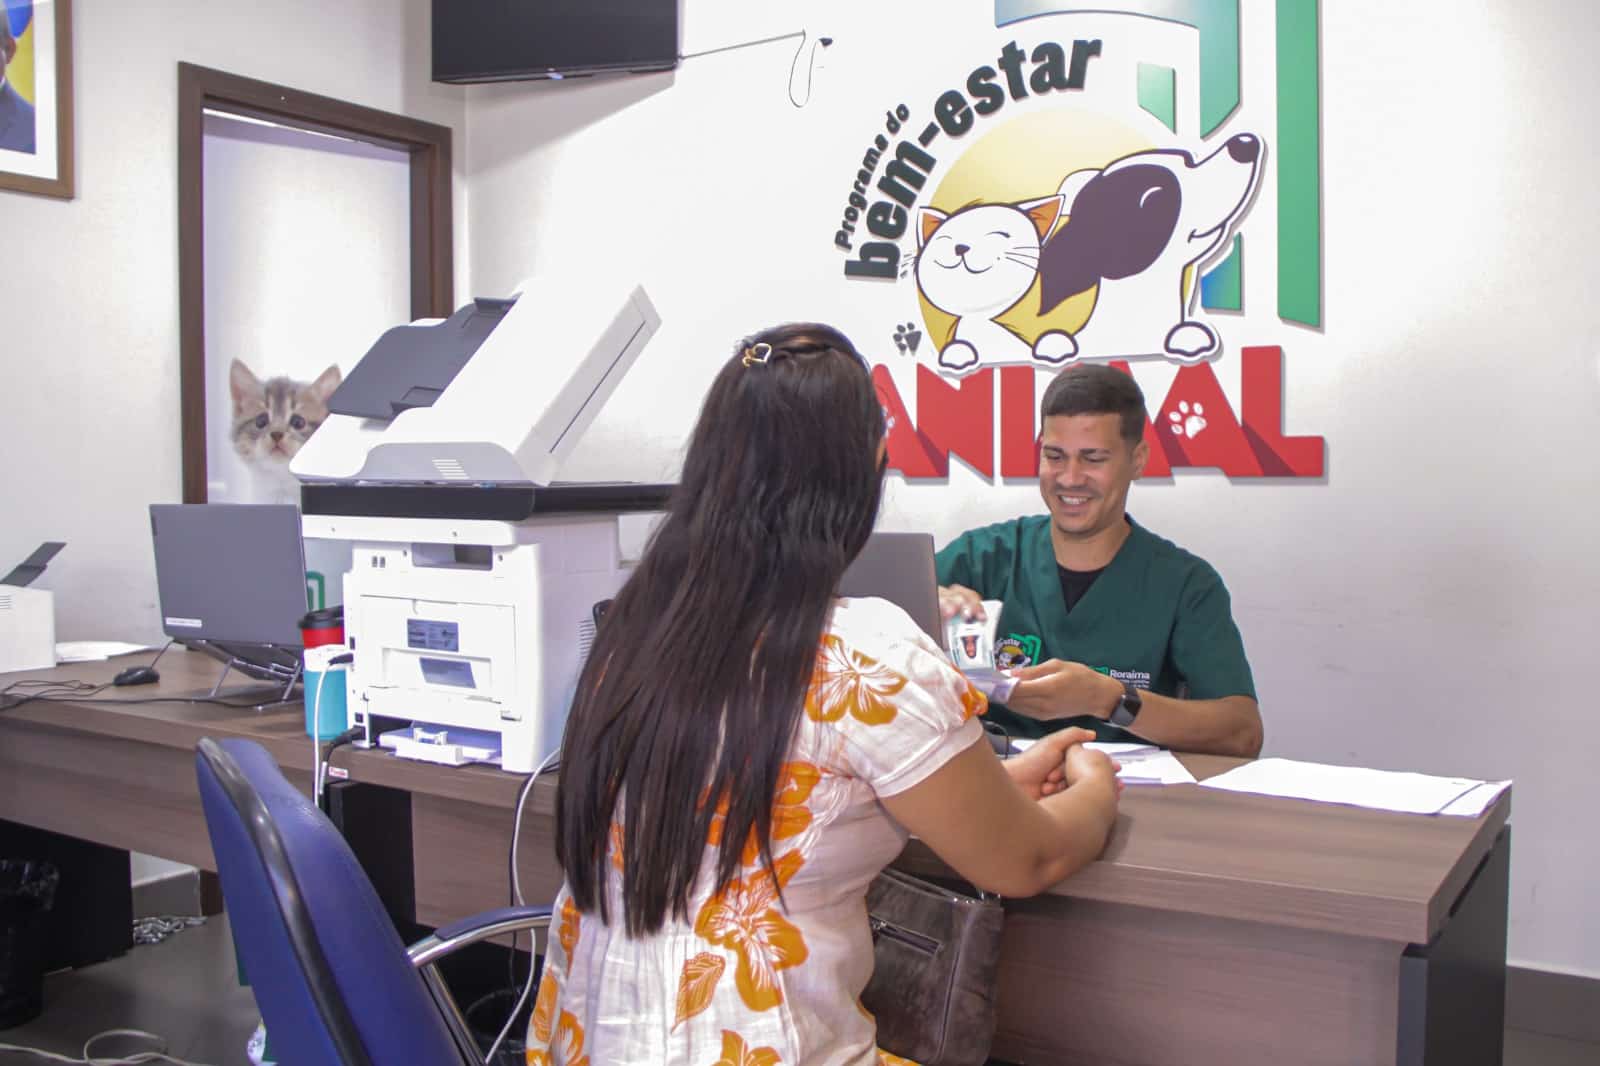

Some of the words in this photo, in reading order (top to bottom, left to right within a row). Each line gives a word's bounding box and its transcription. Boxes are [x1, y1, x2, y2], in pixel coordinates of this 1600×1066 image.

[834, 134, 888, 250] Programa
[886, 103, 909, 135] do
[844, 39, 1102, 279] bem-estar
[872, 346, 1324, 478] ANIAL
[1110, 669, 1150, 679] Roraima
